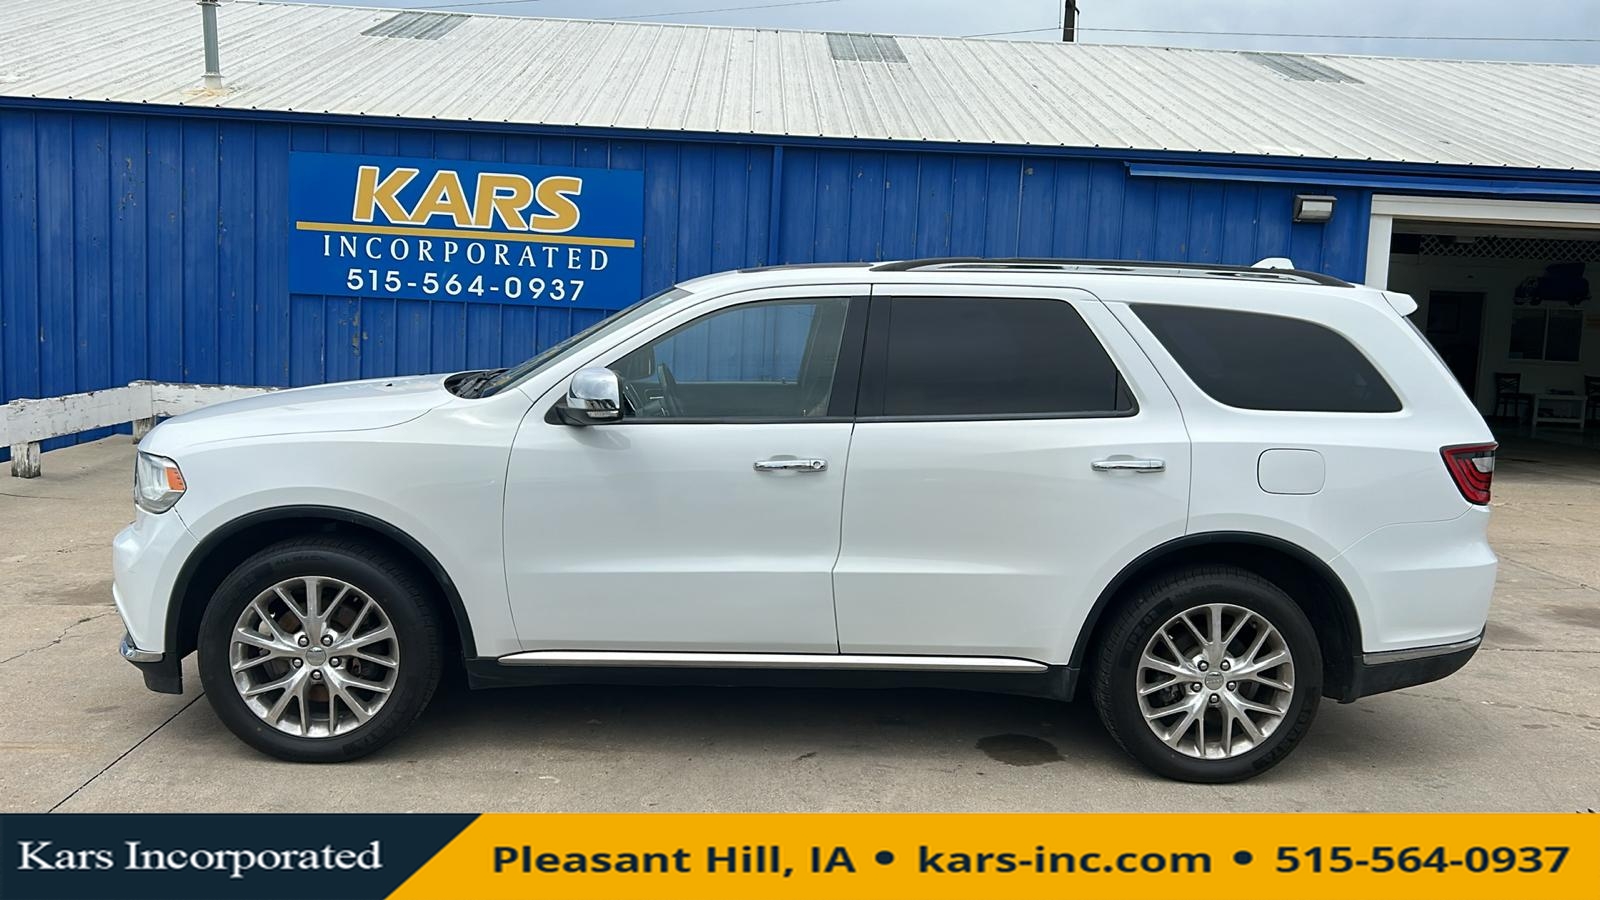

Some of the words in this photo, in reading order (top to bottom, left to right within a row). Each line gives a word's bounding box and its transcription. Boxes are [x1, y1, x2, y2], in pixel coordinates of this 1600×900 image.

[352, 165, 583, 233] KARS
[323, 234, 609, 271] INCORPORATED
[346, 268, 585, 301] 515-564-0937
